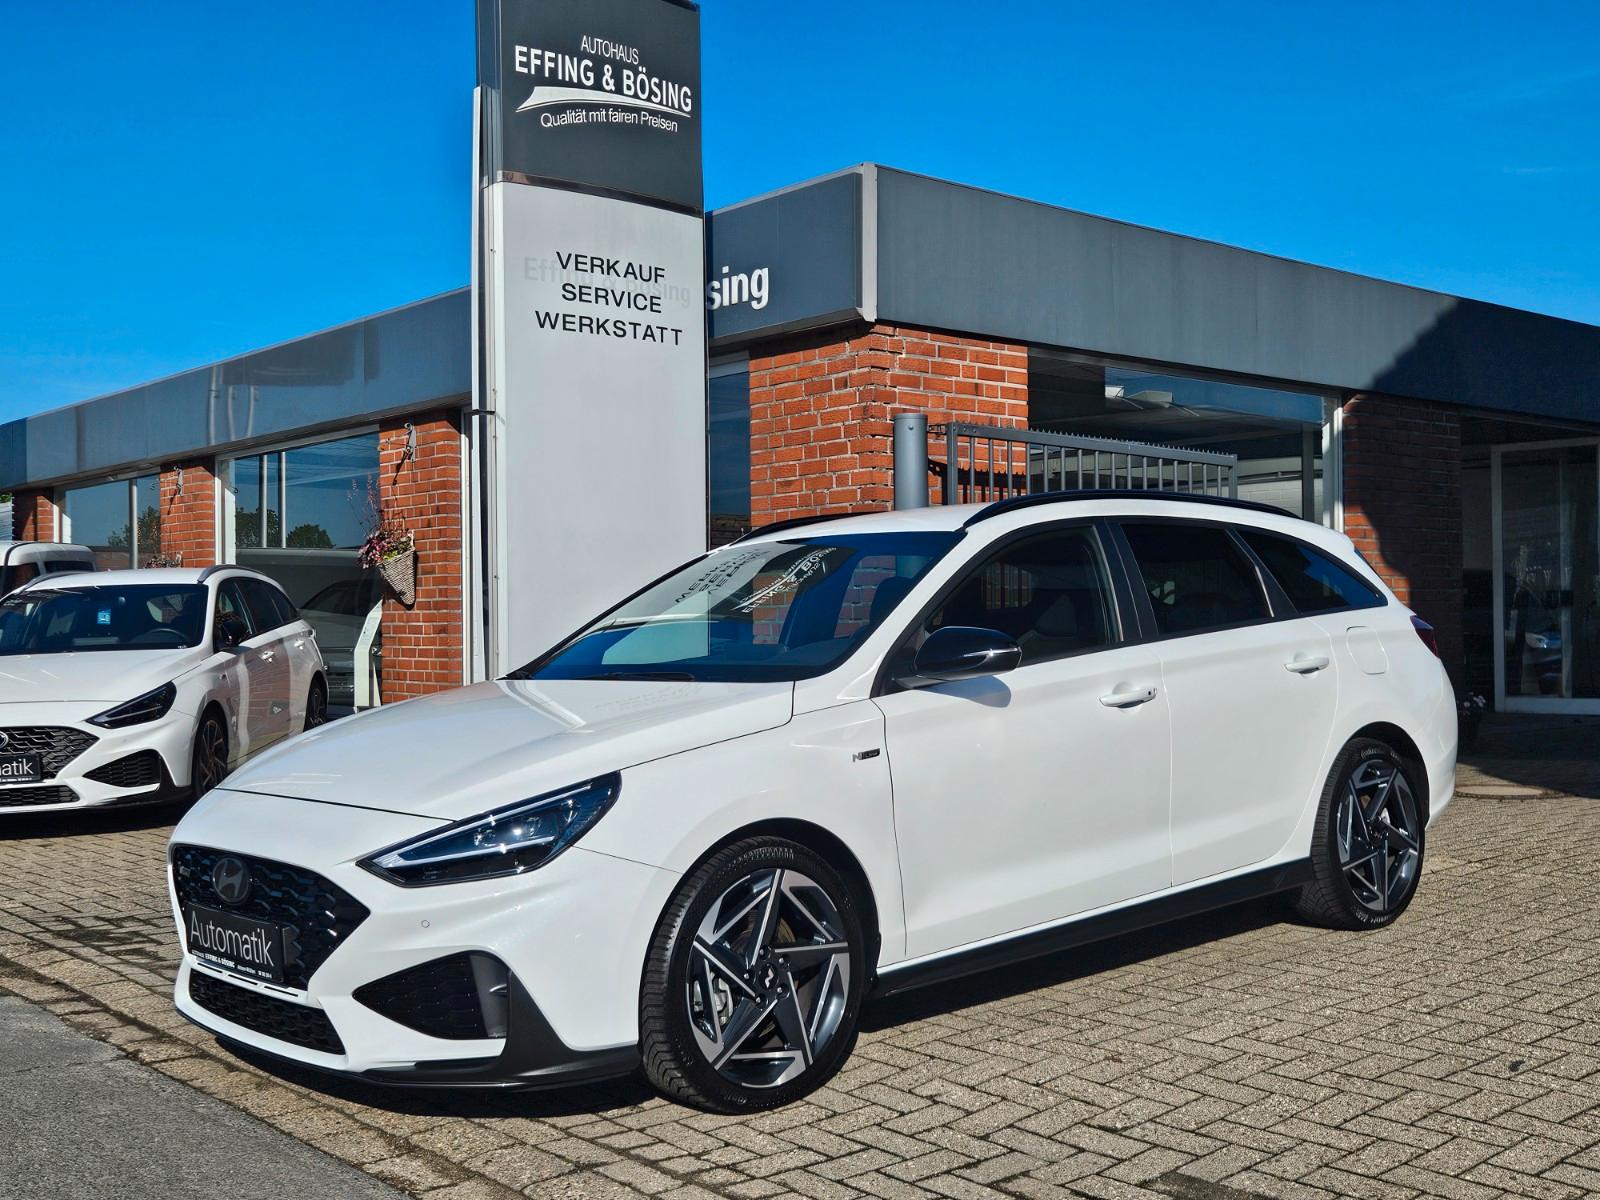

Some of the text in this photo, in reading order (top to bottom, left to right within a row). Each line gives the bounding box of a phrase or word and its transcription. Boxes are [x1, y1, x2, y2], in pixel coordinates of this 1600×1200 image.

[581, 35, 639, 65] AUTOHAUS
[515, 45, 692, 113] EFFING & BÖSING
[540, 108, 678, 133] Qualität mit fairen Preisen
[556, 251, 665, 284] VERKAUF
[561, 283, 662, 314] SERVICE
[535, 310, 683, 346] WERKSTATT
[0, 758, 34, 776] atik
[190, 911, 275, 967] Automatik
